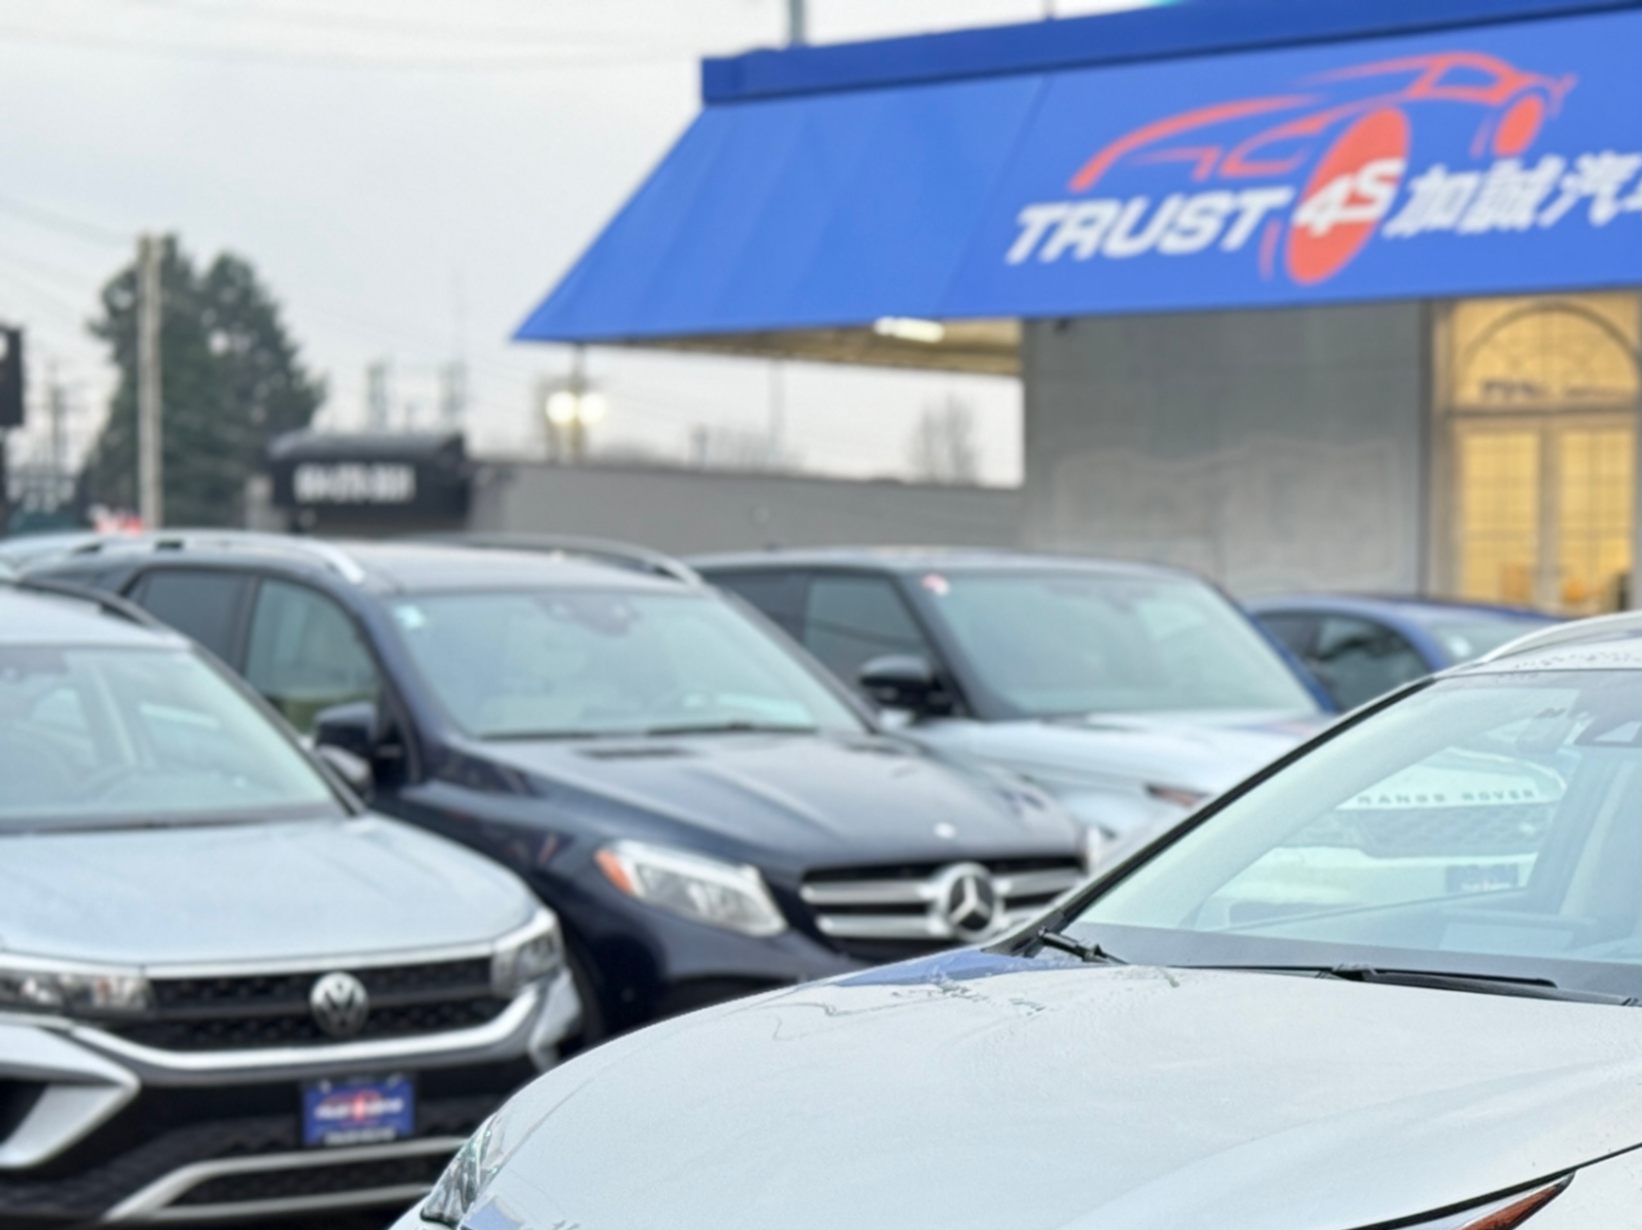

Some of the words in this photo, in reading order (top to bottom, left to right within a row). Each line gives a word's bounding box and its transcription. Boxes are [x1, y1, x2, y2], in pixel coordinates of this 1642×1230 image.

[1004, 185, 1296, 266] TRUST
[1290, 157, 1407, 237] 4S
[1461, 789, 1536, 801] ROVER
